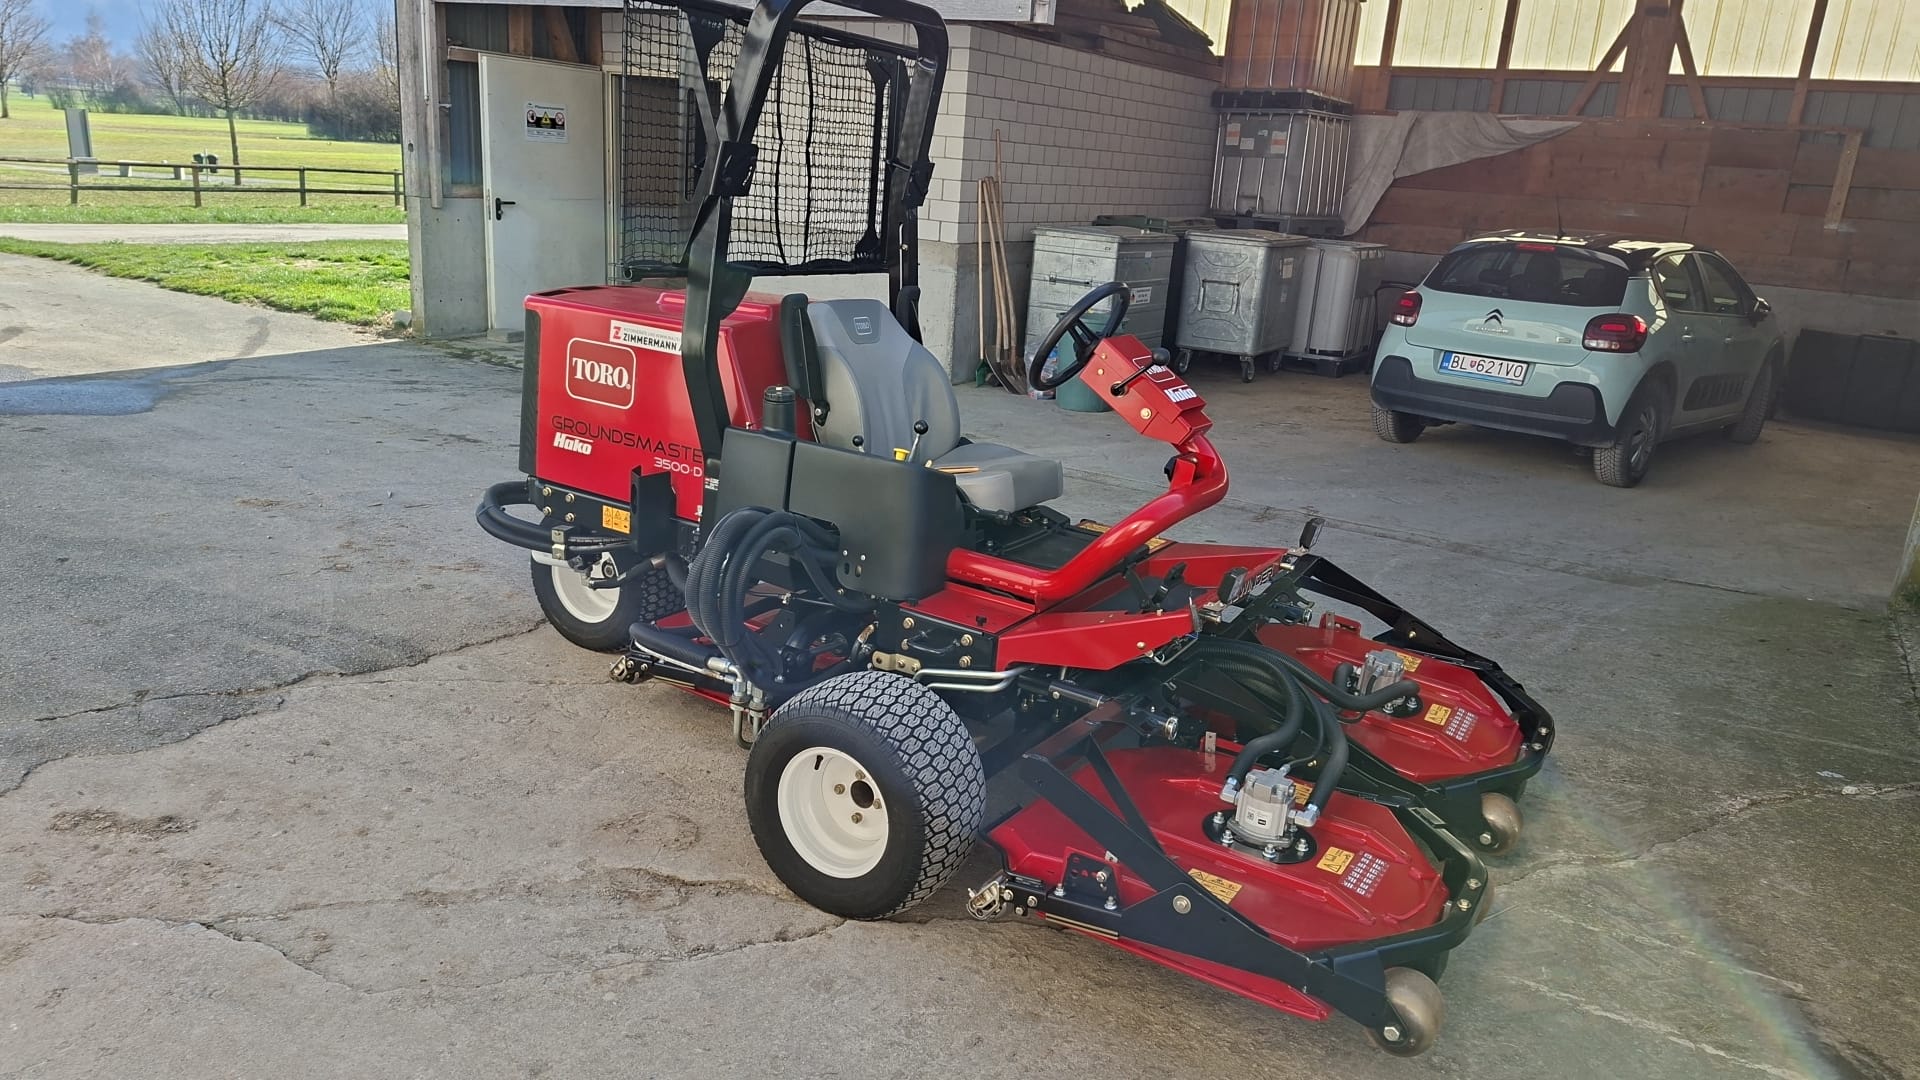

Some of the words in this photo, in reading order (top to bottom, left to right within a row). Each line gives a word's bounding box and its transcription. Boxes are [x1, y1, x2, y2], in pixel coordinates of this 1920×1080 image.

[623, 333, 677, 350] ZIMMERMANN
[1450, 355, 1468, 370] BL
[551, 415, 704, 464] GROUNDSMASTE
[553, 432, 594, 455] Hako
